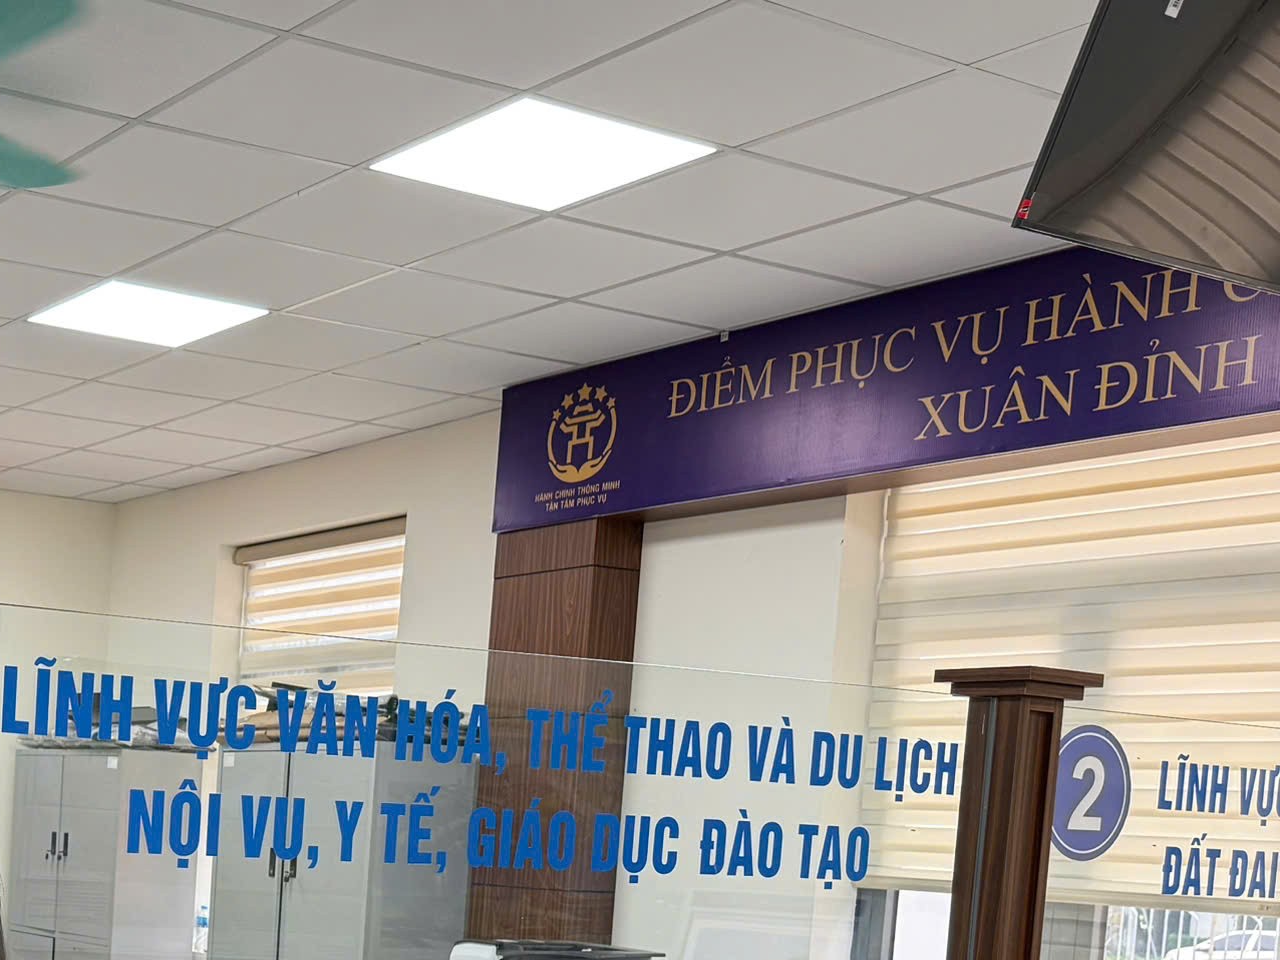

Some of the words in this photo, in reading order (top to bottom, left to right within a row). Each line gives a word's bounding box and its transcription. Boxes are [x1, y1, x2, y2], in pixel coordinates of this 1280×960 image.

[666, 356, 776, 420] ĐIỂM
[786, 327, 917, 395] PHỤC
[930, 305, 1008, 367] VỤ
[1022, 269, 1201, 346] HÀNH
[913, 364, 1080, 441] XUÂN
[1092, 334, 1262, 412] ĐỈNH
[1, 656, 134, 742] LĨNH
[154, 676, 257, 760] VỰC
[276, 679, 378, 758] VĂN
[395, 688, 507, 776] HÓA,
[526, 689, 615, 773] THỂ
[624, 714, 732, 780] THAO
[748, 716, 796, 784] VÀ
[809, 731, 863, 790] DU
[874, 736, 959, 802] LỊCH
[126, 778, 222, 869] NỘI
[334, 800, 365, 862] Y
[379, 785, 447, 873] TẾ,
[466, 798, 576, 871] GIÁO
[591, 812, 680, 885] DỤC
[699, 808, 783, 878] ĐÀO
[797, 823, 870, 890] TẠO
[1067, 755, 1105, 832] 2
[1157, 754, 1230, 814] LĨNH
[1239, 765, 1280, 827] VỰ
[1161, 833, 1221, 896] ĐẤT
[1228, 849, 1279, 899] ĐAI
